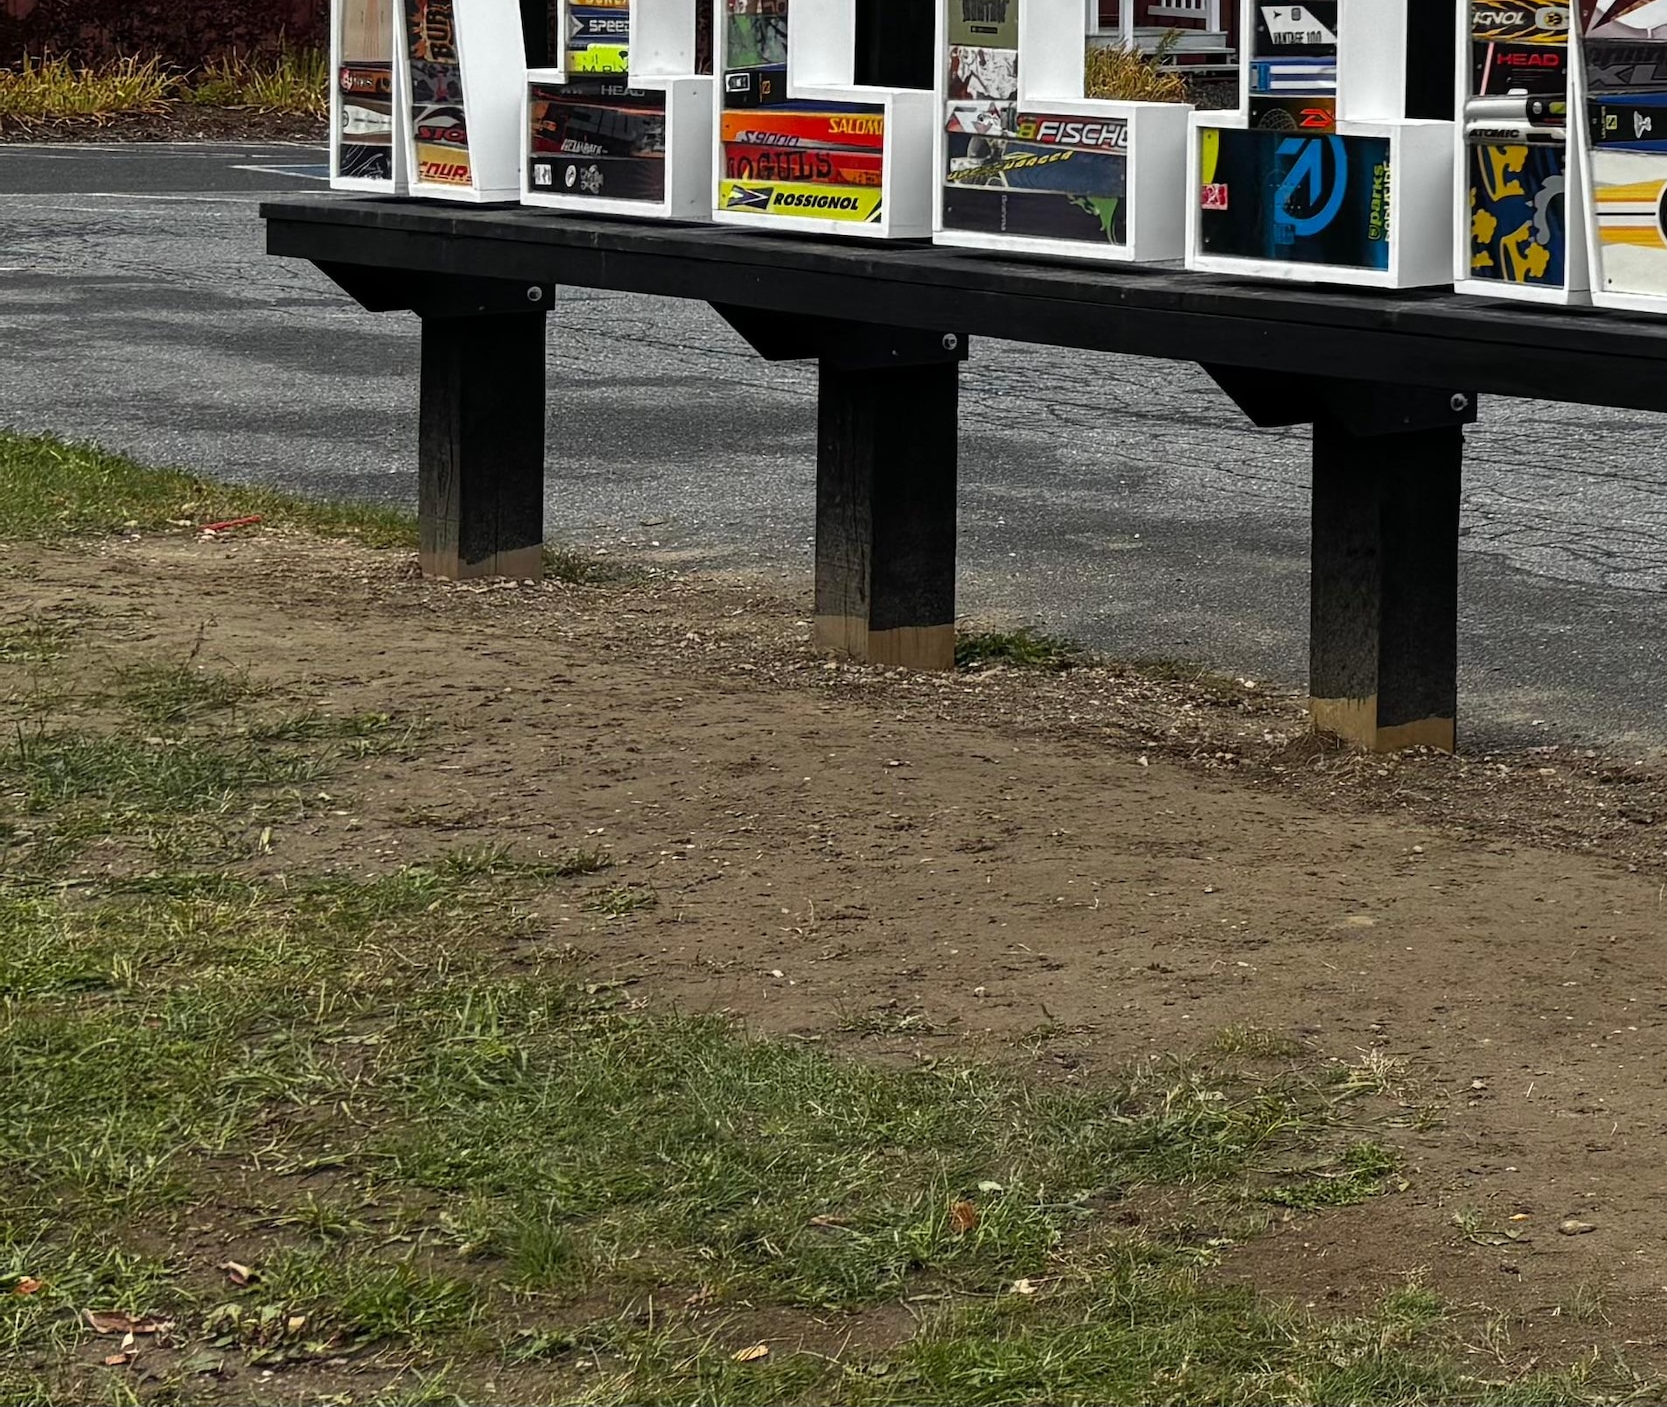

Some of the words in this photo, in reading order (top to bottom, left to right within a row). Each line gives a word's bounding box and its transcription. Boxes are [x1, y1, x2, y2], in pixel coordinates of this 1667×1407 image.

[1497, 53, 1560, 67] HEAD
[828, 116, 883, 134] SALOM
[772, 192, 859, 211] ROSSIGNOL
